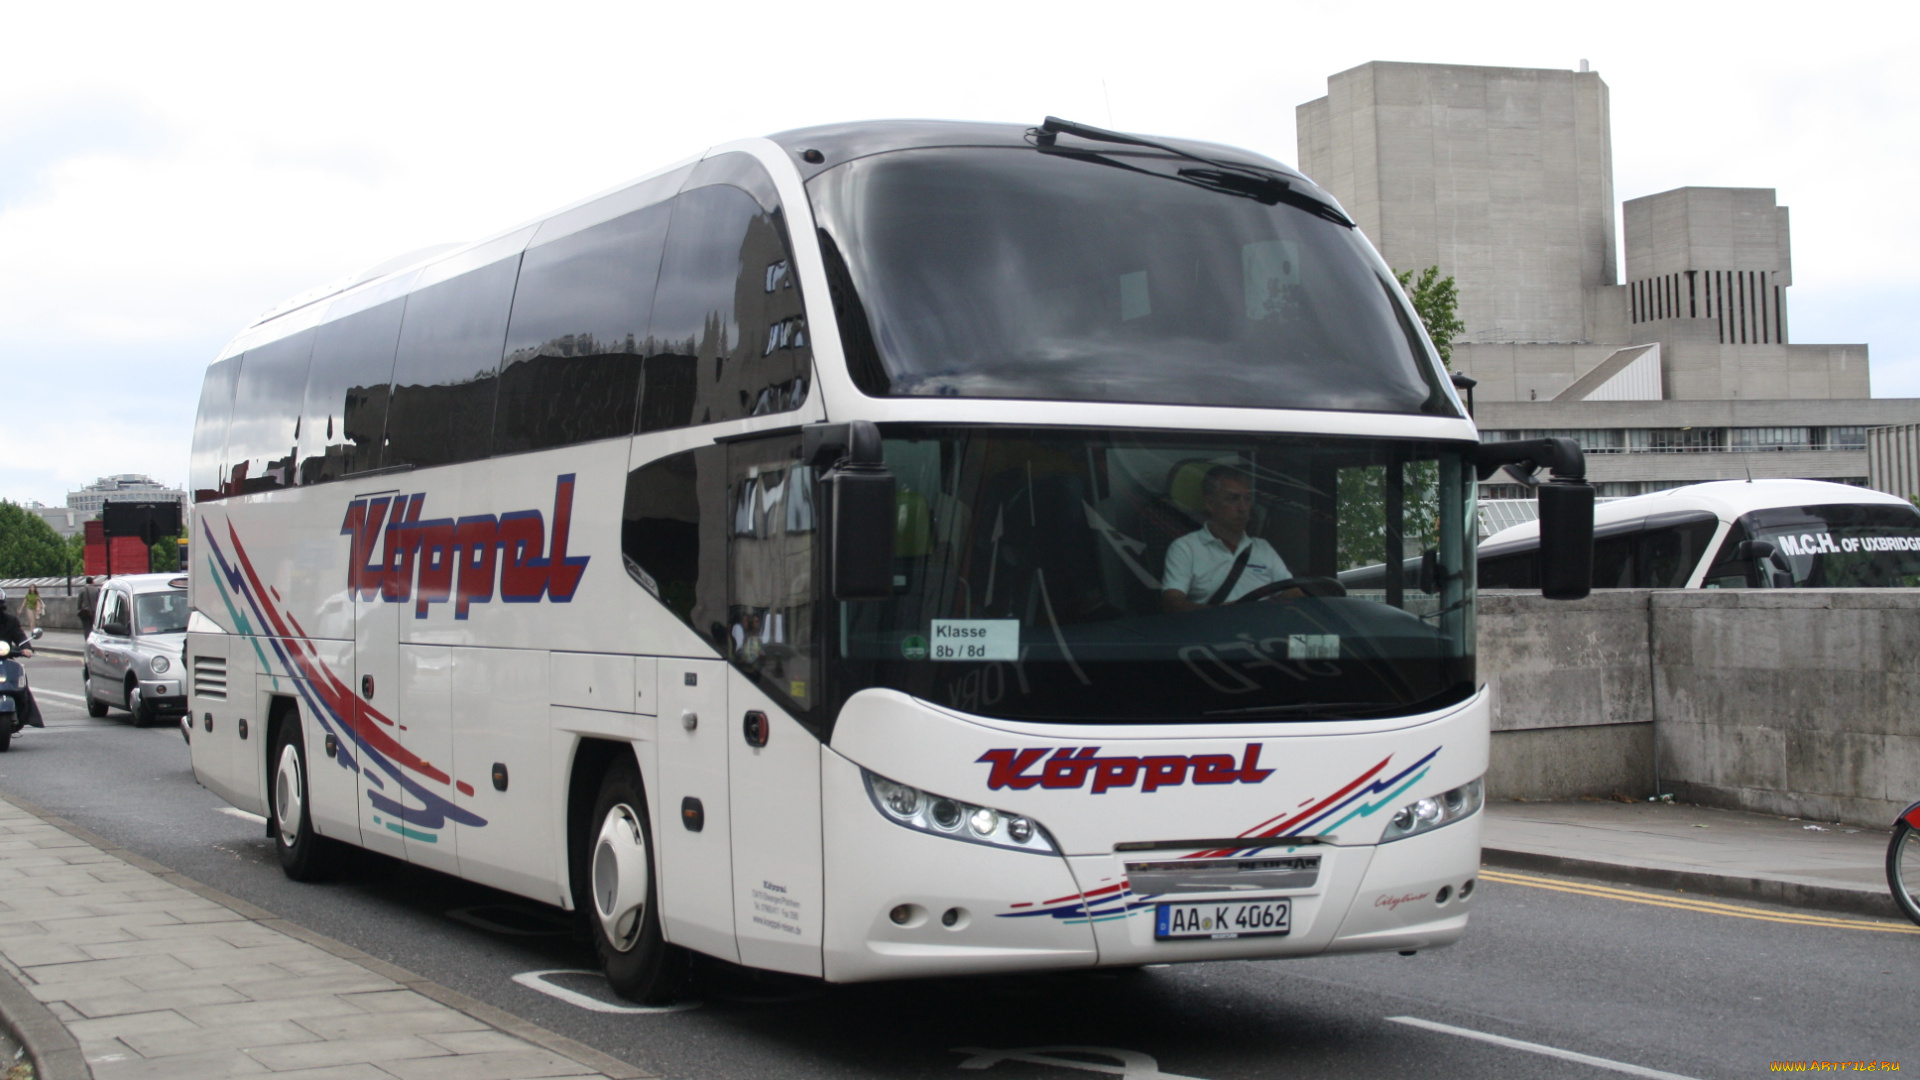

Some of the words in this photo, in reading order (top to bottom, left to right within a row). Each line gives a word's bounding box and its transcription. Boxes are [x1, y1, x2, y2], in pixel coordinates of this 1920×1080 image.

[340, 473, 591, 620] Köppel
[1778, 532, 1841, 556] M.C.H.
[1841, 538, 1860, 552] OF
[936, 624, 987, 638] Klasse
[936, 645, 954, 658] 8b
[967, 645, 985, 657] 8d
[974, 743, 1277, 794] Köppel
[1172, 908, 1200, 932] AA
[1215, 907, 1229, 929] K
[1235, 904, 1287, 928] 4062
